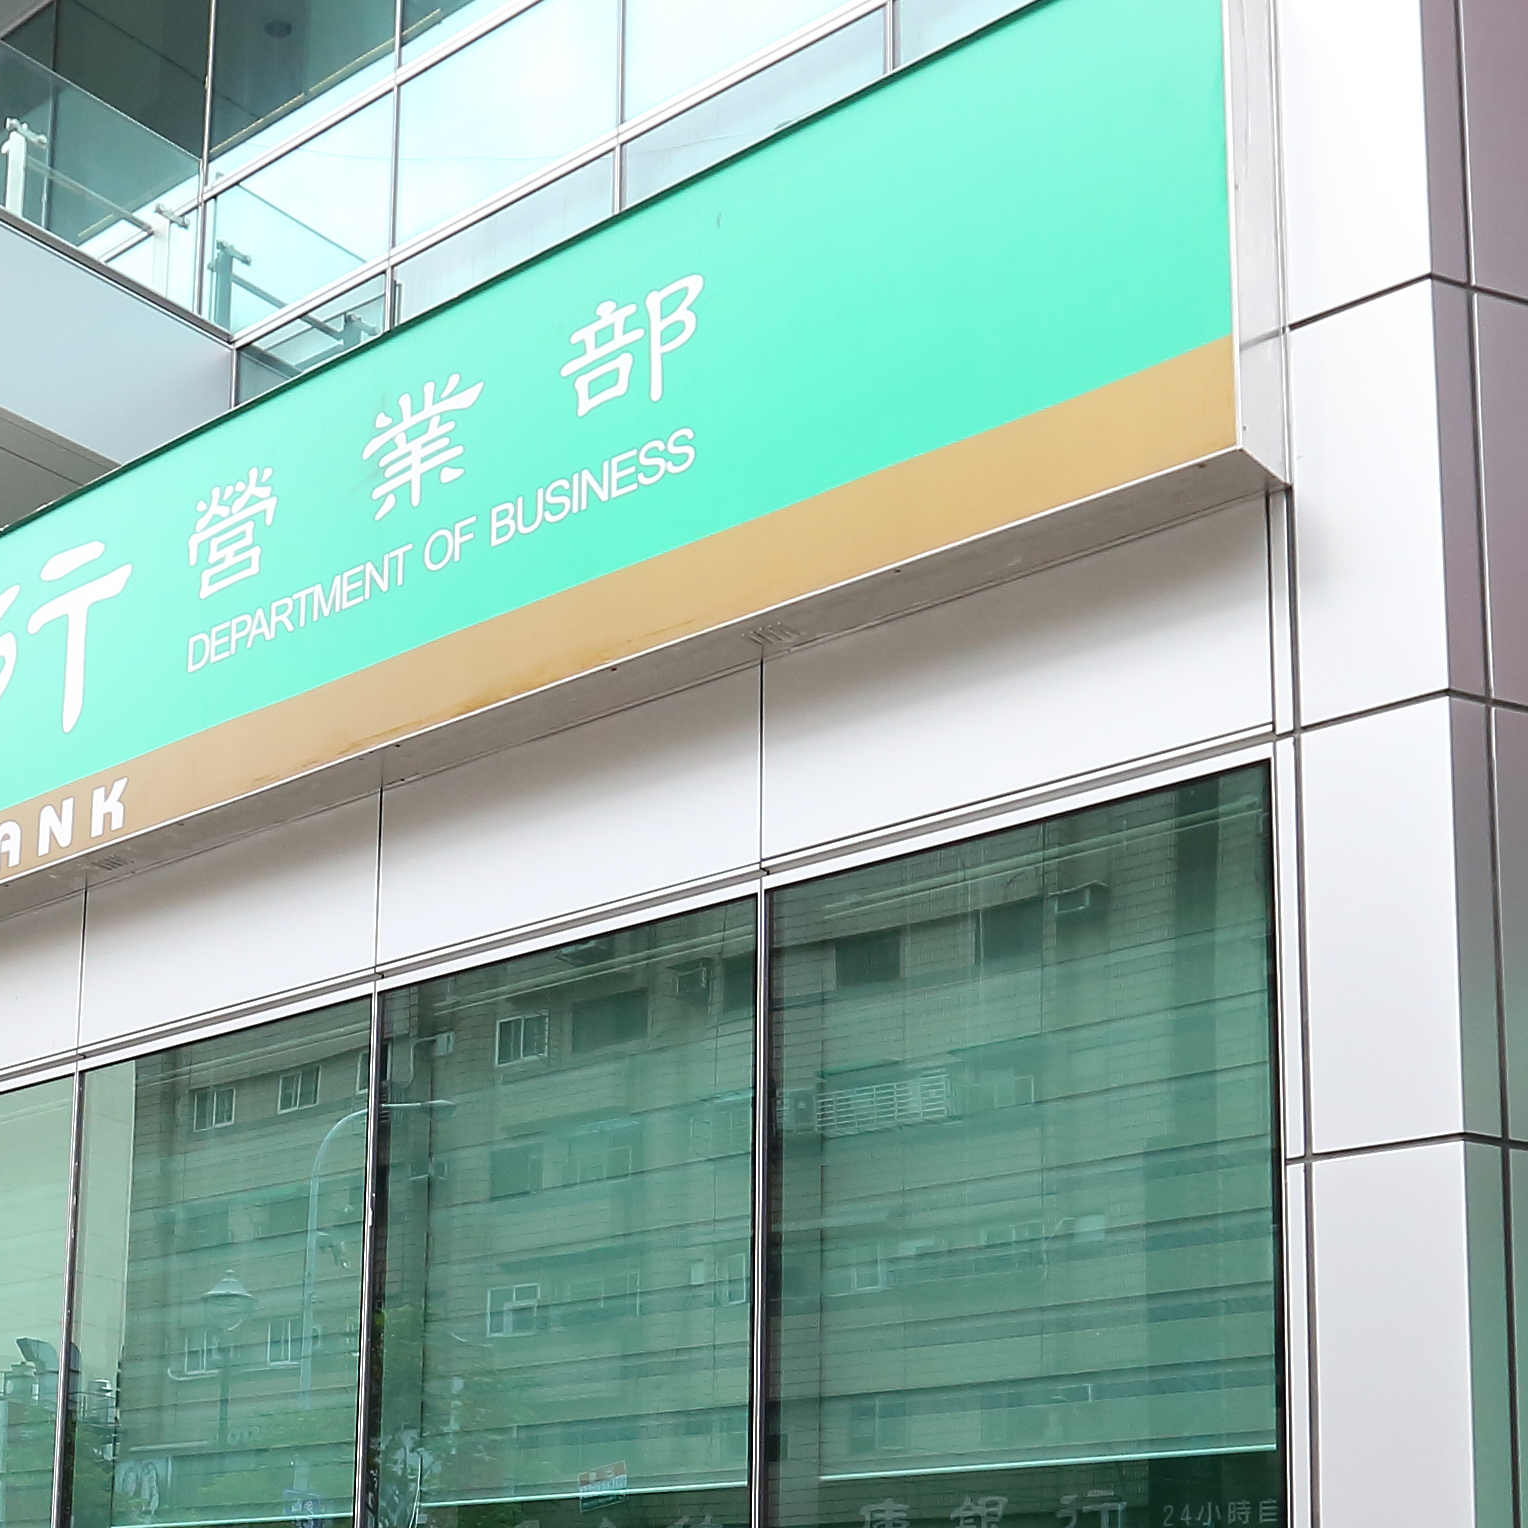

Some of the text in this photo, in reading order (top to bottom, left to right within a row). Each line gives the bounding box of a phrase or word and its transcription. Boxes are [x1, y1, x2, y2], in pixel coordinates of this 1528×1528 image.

[186, 427, 697, 673] DEPARTMENT OF BUSINESS
[187, 274, 705, 601] 營業部
